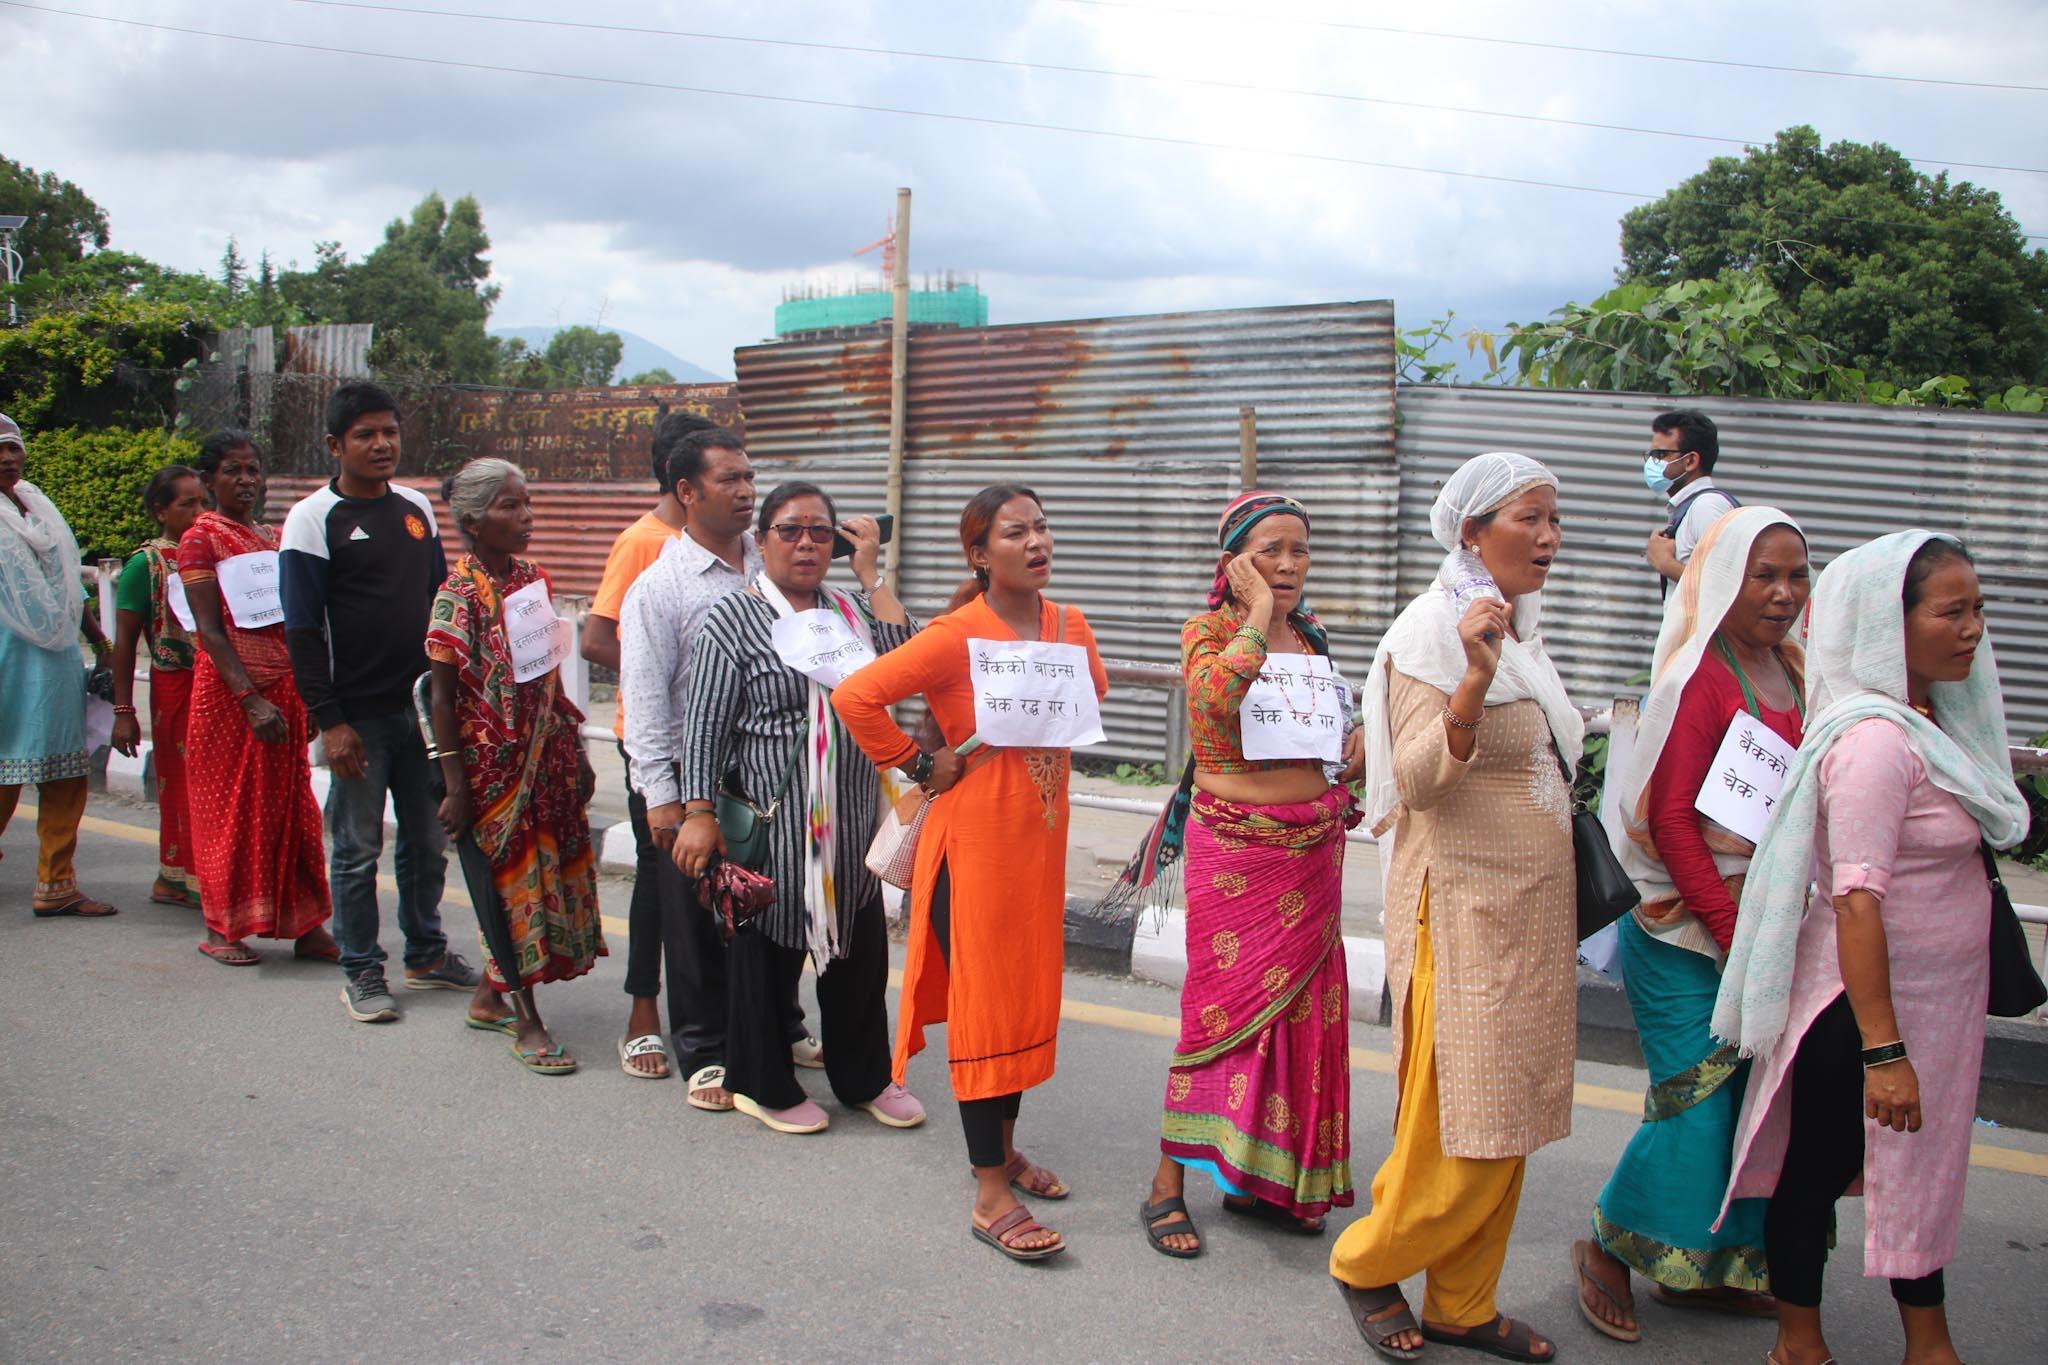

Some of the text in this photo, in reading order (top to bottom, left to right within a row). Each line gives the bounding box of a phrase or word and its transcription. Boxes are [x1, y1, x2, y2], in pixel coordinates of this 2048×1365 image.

[978, 651, 1075, 680] बैंकको बाउन्स
[983, 692, 1013, 713] चेक
[1047, 700, 1066, 717] गर
[1251, 704, 1283, 726] चेक
[1317, 713, 1337, 732] गर
[1739, 729, 1788, 779] बैंकको
[1723, 768, 1758, 799] चेक
